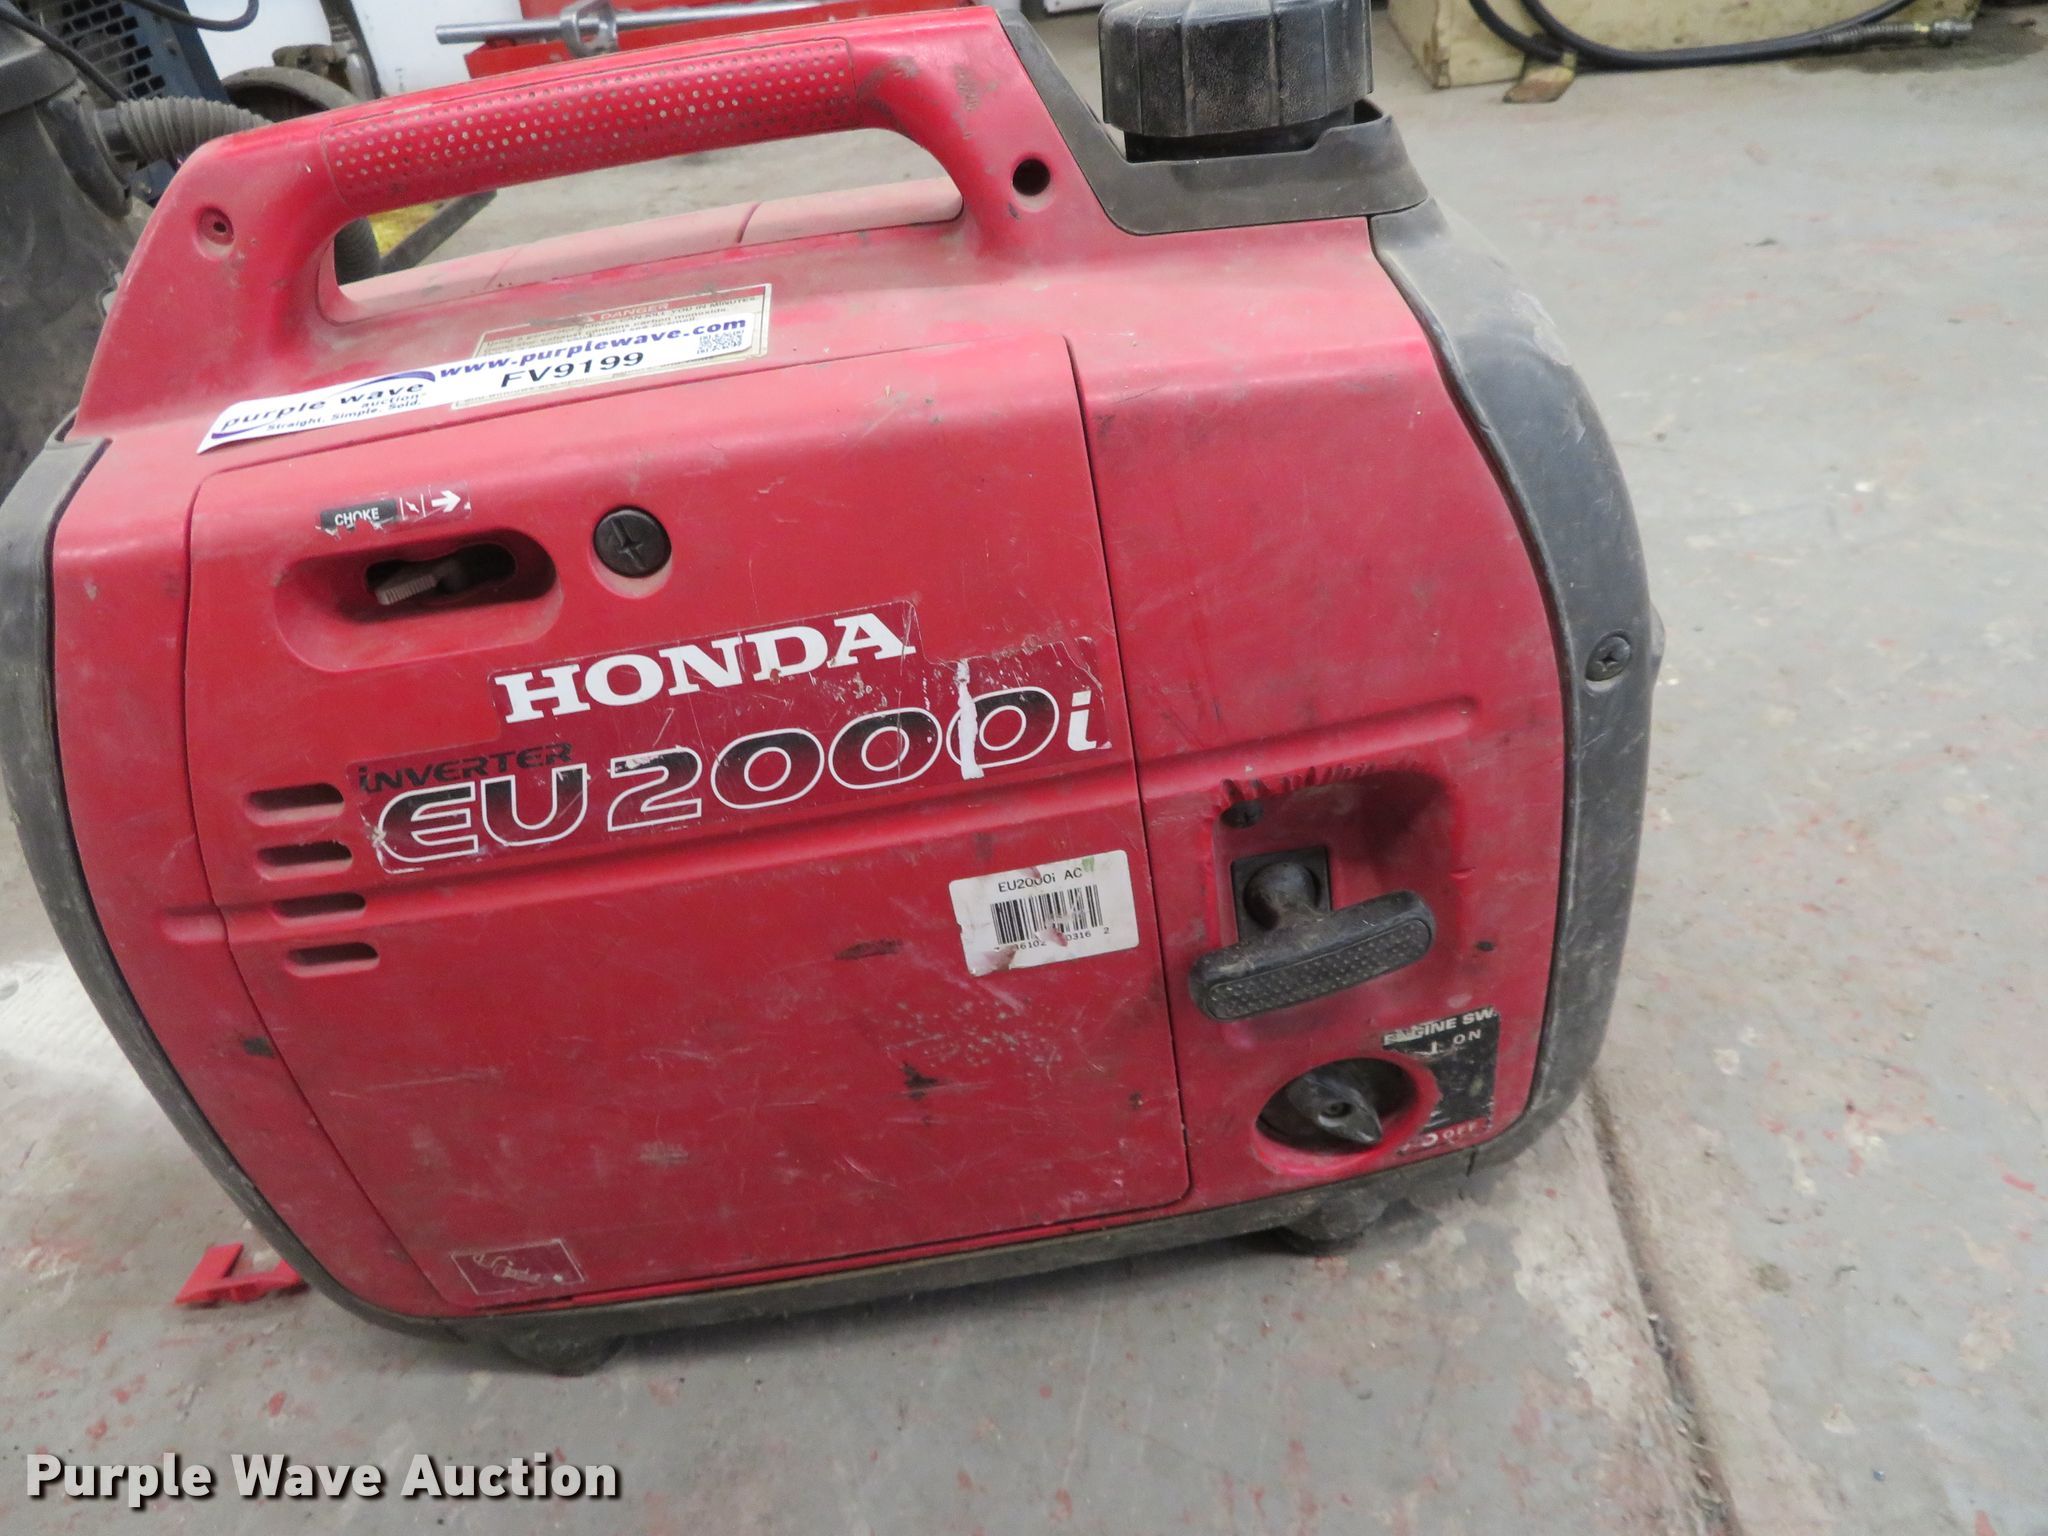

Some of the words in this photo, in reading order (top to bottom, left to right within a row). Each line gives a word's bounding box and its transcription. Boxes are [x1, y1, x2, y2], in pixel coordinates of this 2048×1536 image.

[440, 319, 746, 378] www.purplewave.com
[501, 352, 643, 387] FV9199
[221, 400, 326, 431] purple
[340, 383, 424, 404] wave
[334, 507, 380, 528] CHOKE
[495, 613, 916, 723] HONDA
[376, 686, 1098, 862] EU2000i
[998, 872, 1056, 893] EU2000i
[1064, 867, 1083, 881] AC
[1453, 1028, 1482, 1045] ON
